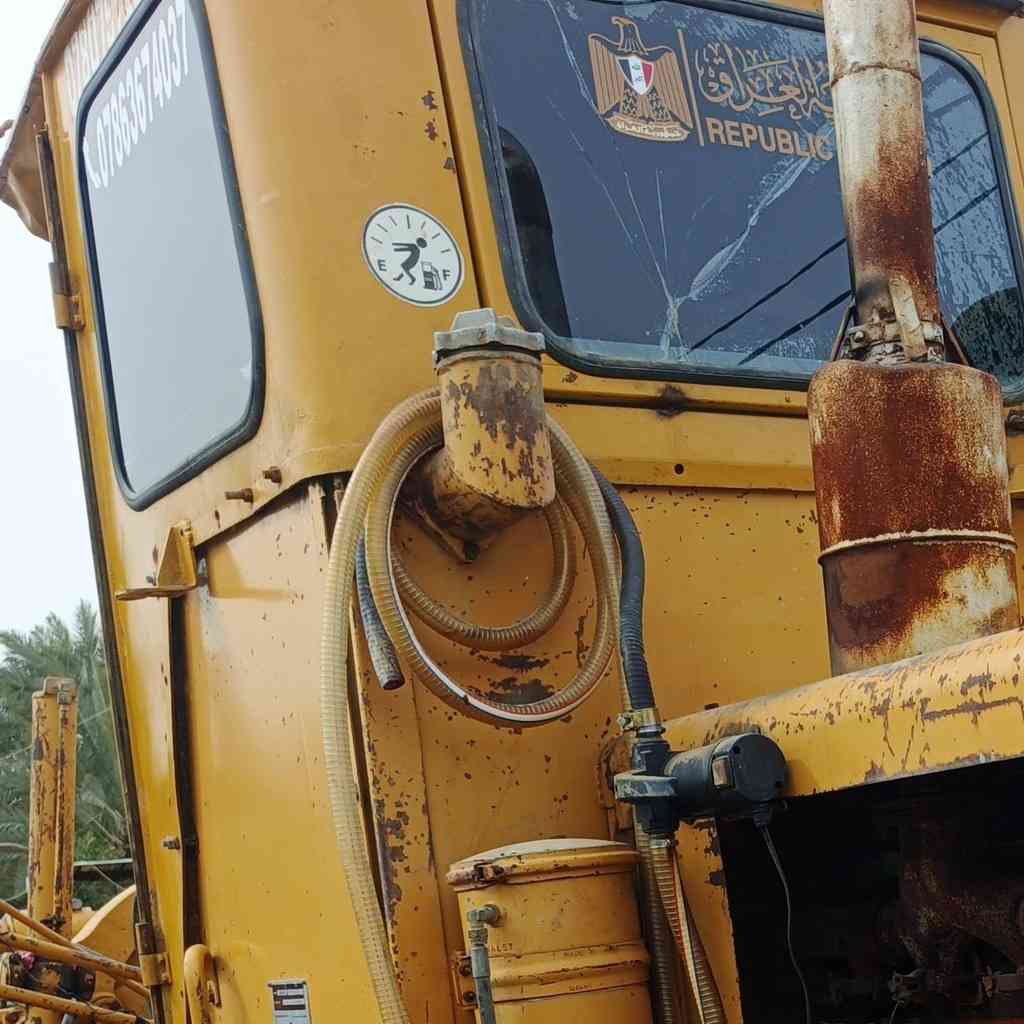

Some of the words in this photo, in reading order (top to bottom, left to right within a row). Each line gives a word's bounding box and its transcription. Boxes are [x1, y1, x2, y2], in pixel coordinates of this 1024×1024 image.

[96, 0, 188, 188] 07863674037
[705, 117, 833, 161] REPUBLIC
[377, 259, 387, 271] E
[442, 269, 451, 281] F
